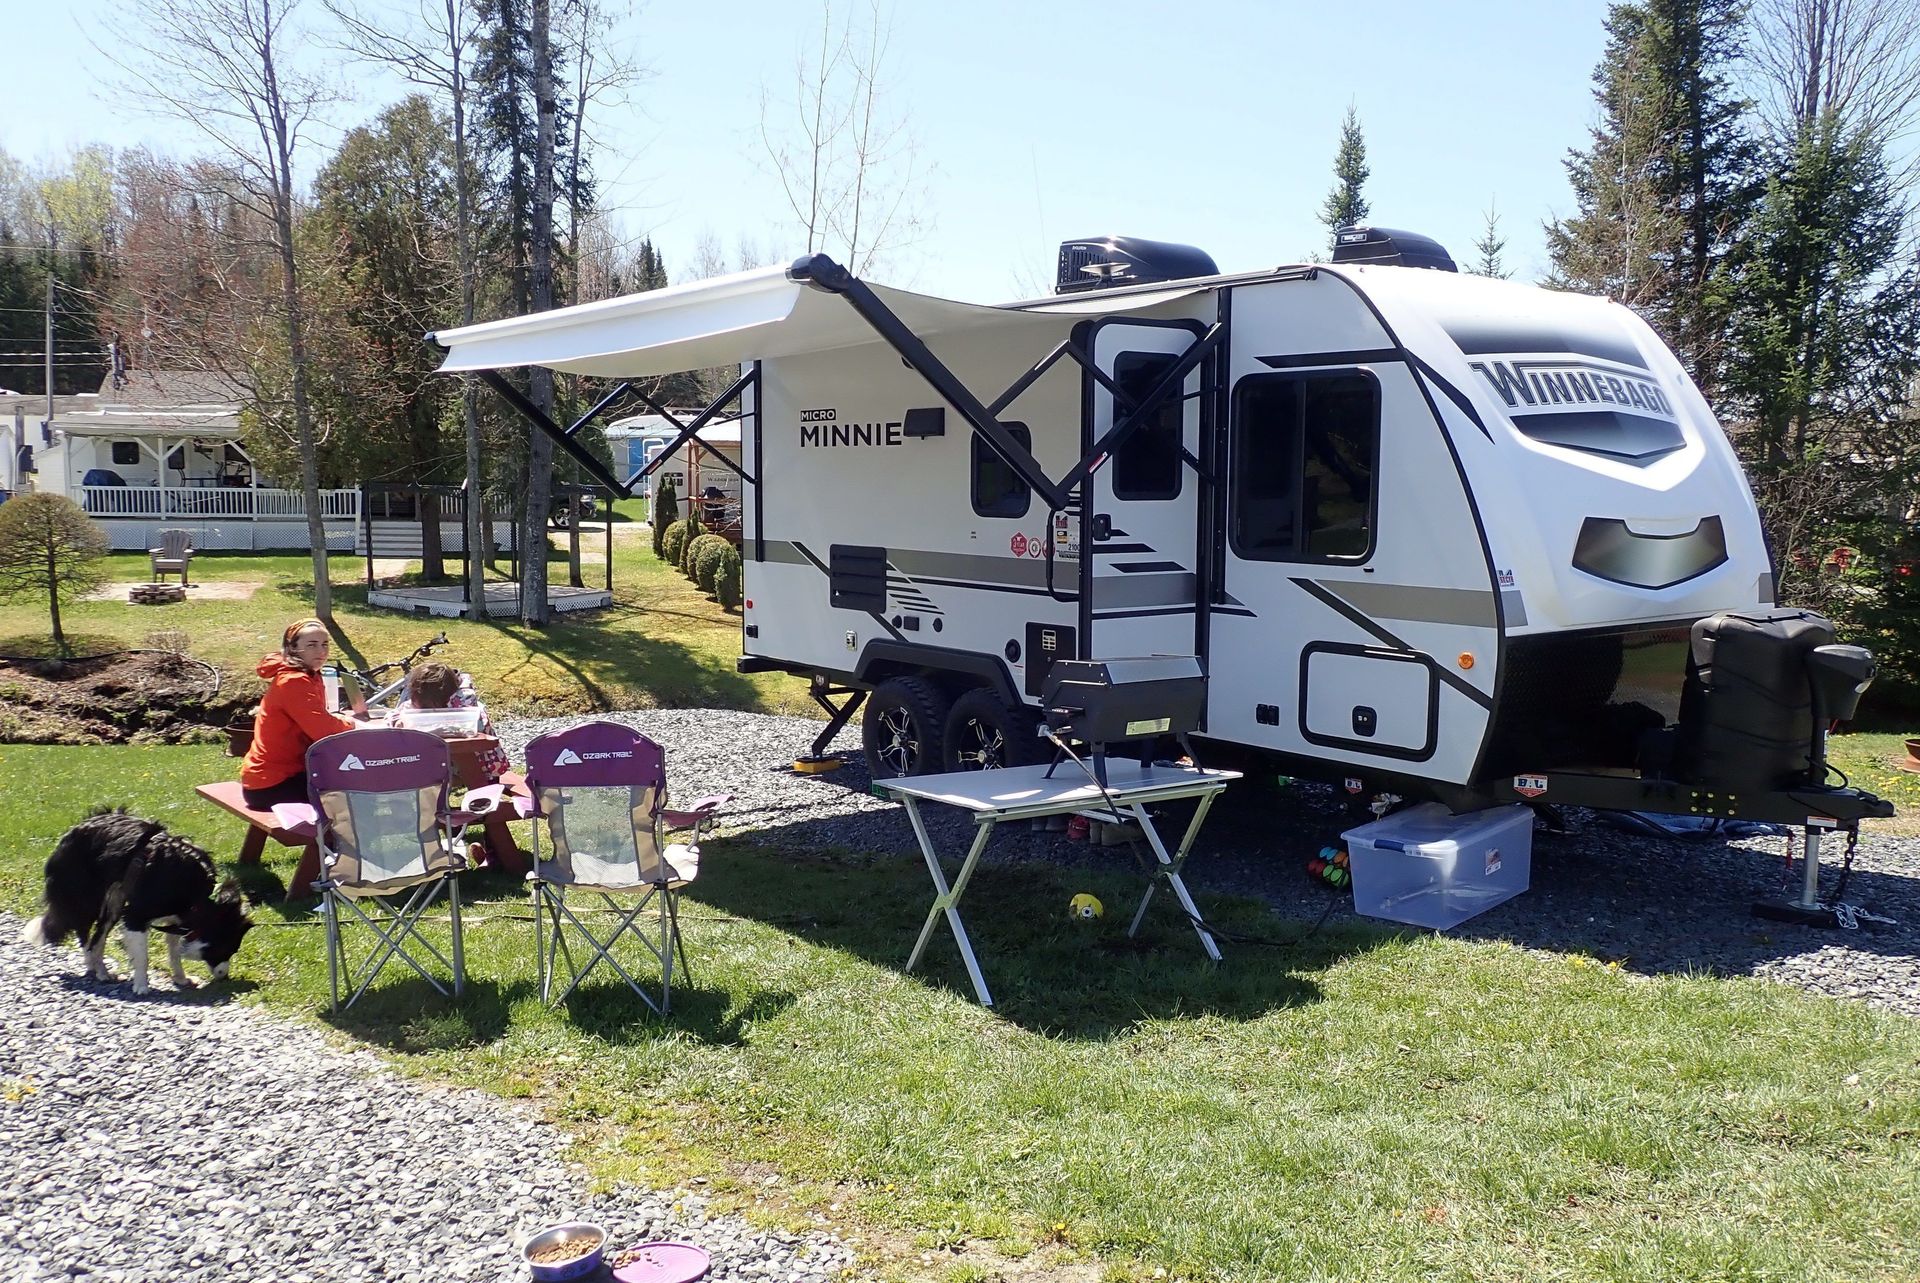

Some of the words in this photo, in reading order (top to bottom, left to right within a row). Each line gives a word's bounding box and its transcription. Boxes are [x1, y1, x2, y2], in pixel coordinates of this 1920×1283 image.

[1467, 360, 1675, 417] WINNEBAGO
[801, 410, 835, 421] MICRO
[801, 422, 902, 447] MINNIE
